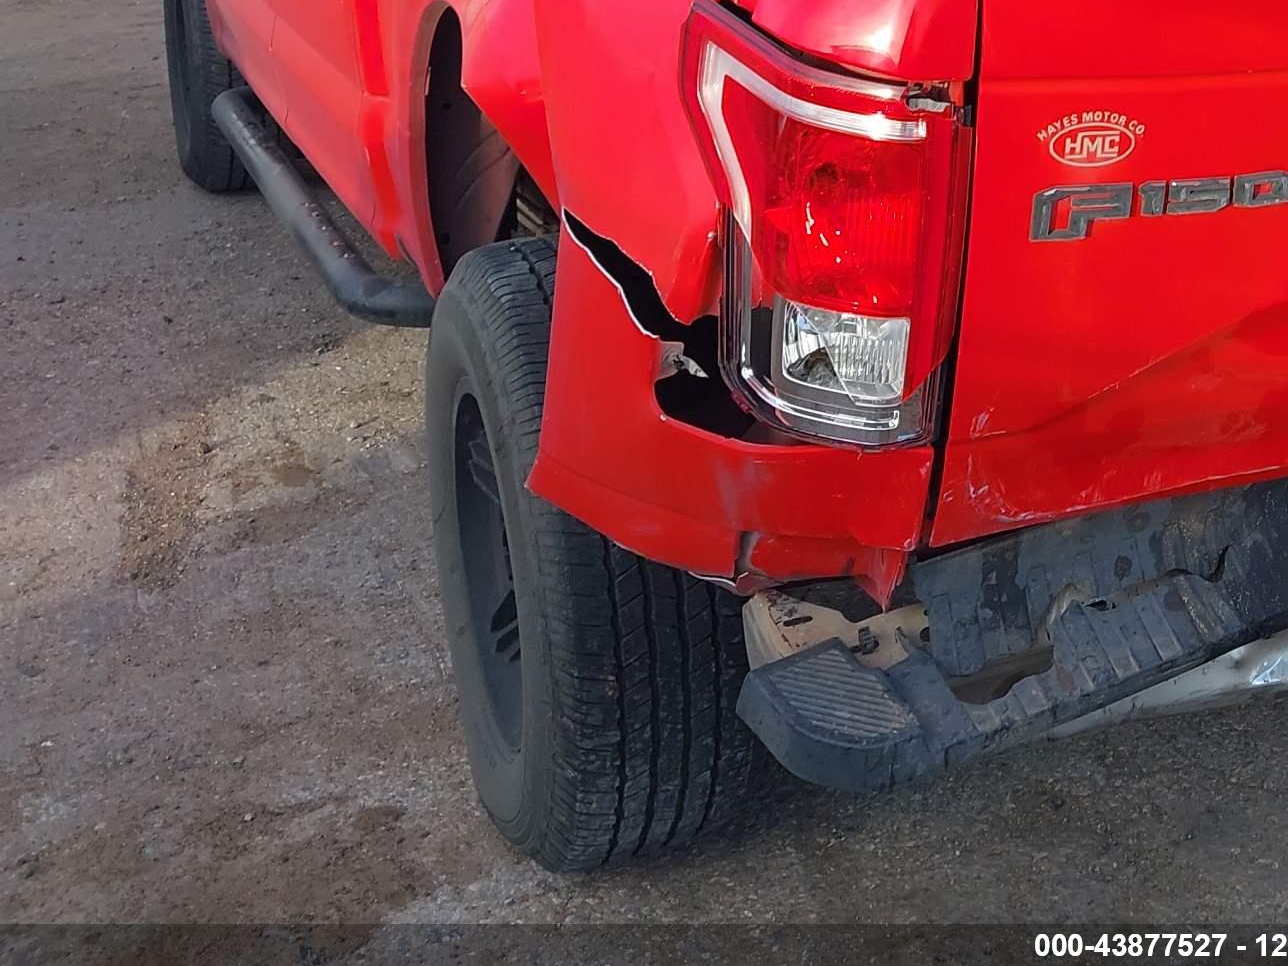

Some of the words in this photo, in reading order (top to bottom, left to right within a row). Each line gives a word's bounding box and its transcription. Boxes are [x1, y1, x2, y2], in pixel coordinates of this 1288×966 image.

[1037, 113, 1078, 142] HAYES
[1082, 111, 1127, 127] MOTOR
[1064, 130, 1121, 160] HMC
